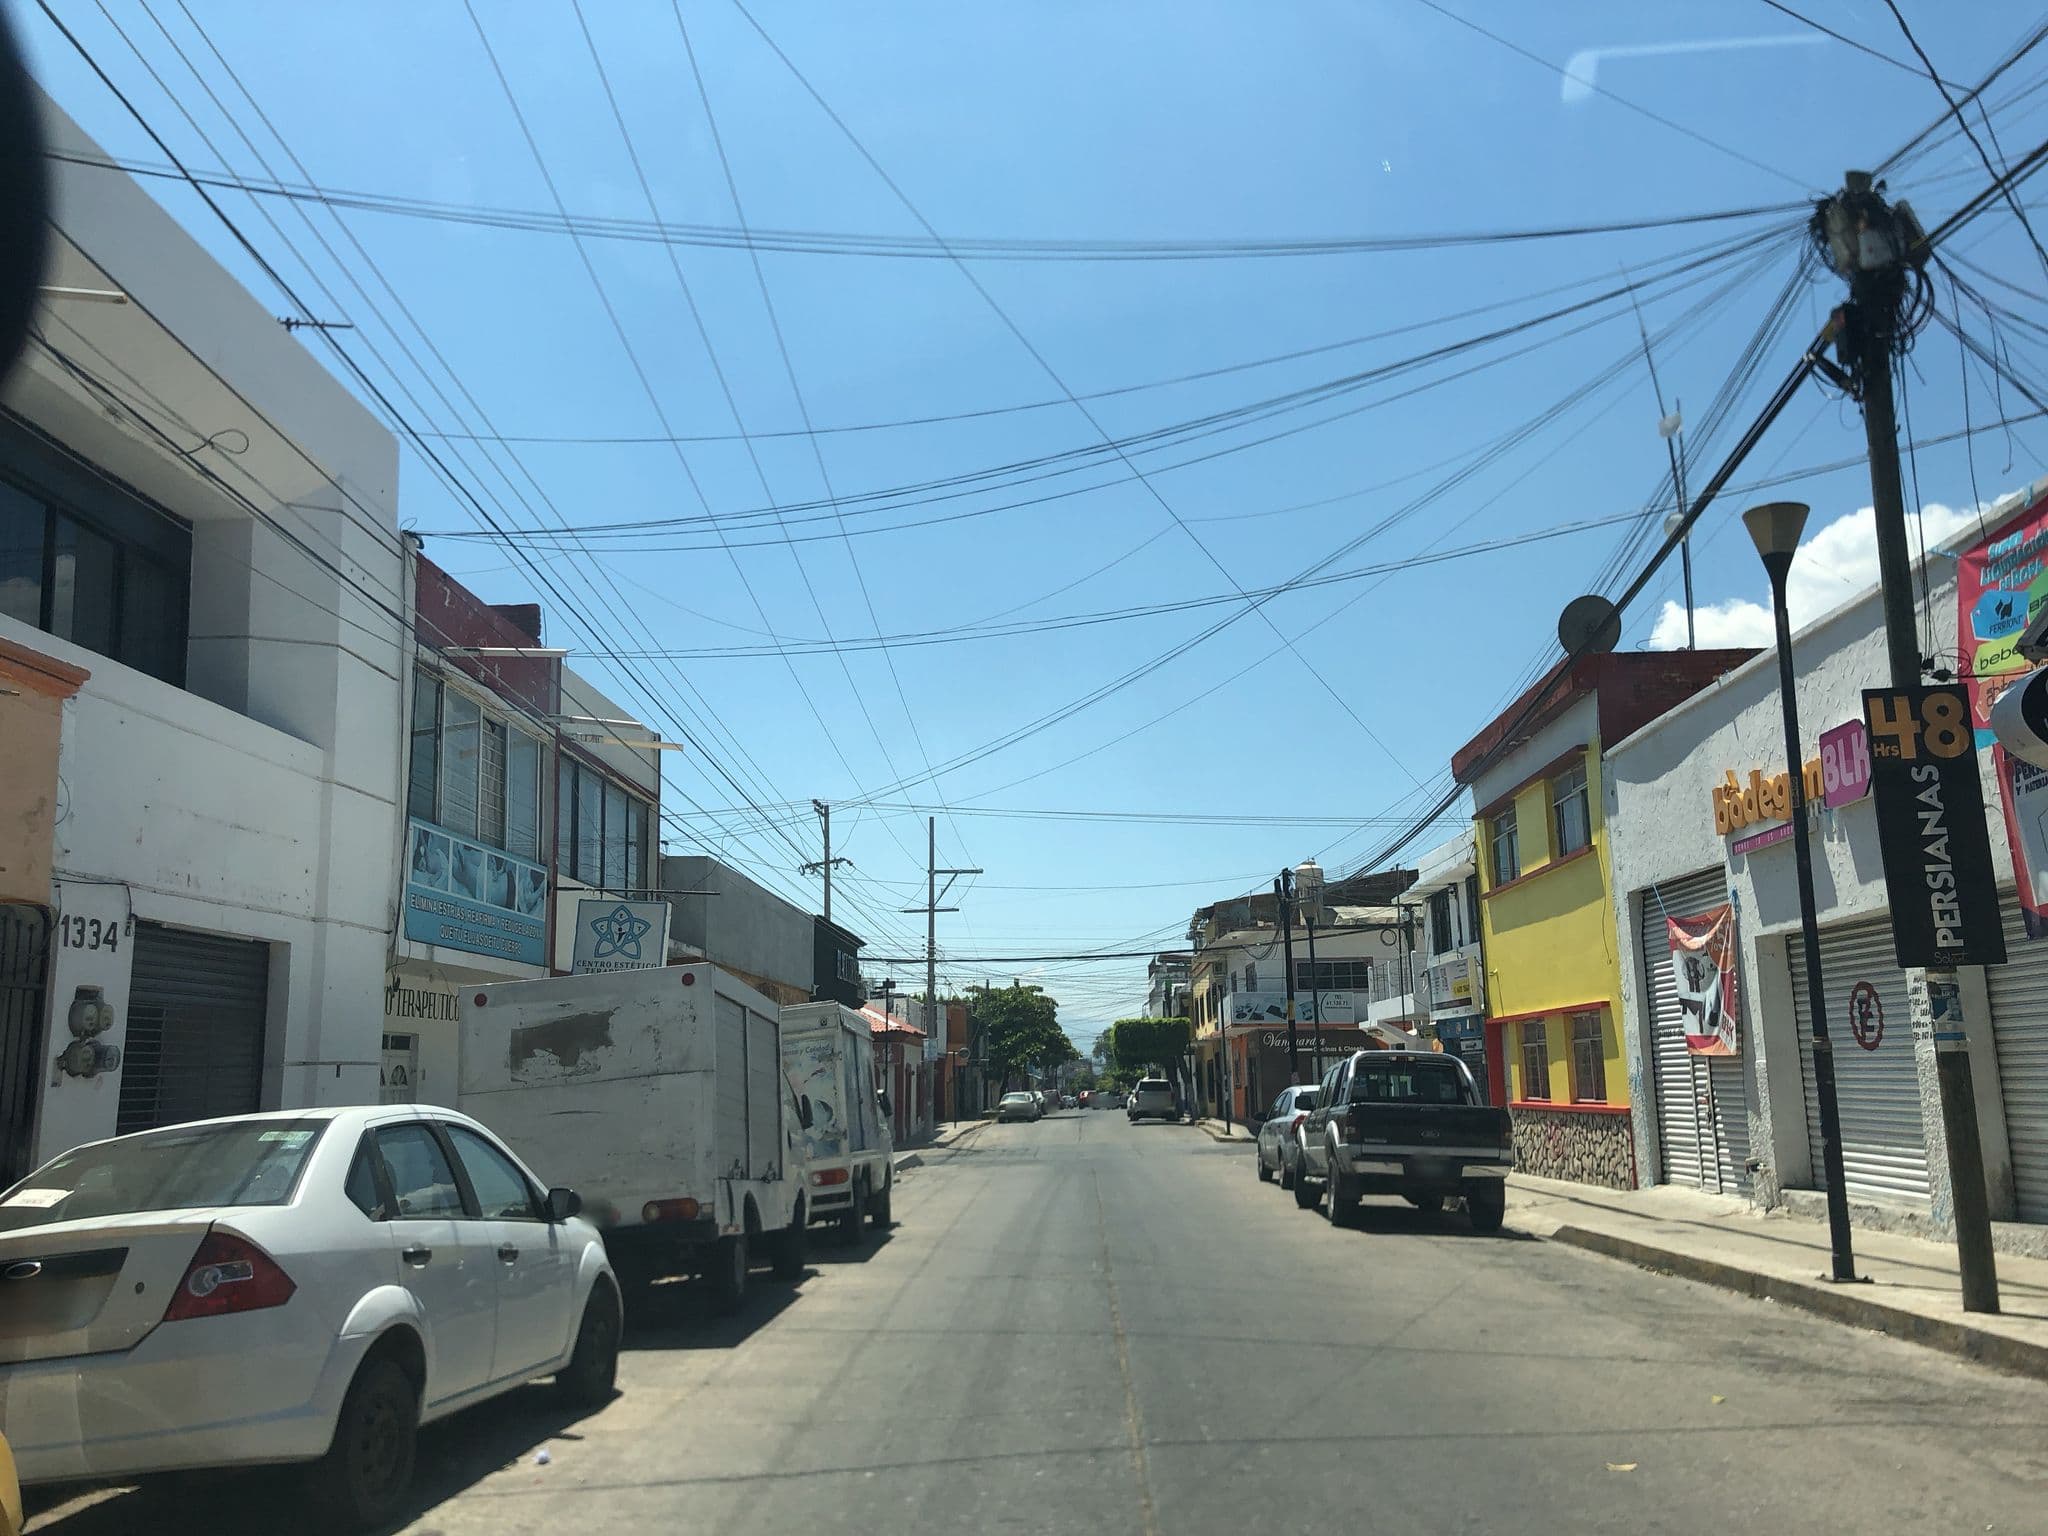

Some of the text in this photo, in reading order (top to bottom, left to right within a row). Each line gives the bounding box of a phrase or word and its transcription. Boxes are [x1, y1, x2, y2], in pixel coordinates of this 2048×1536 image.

[1868, 692, 1970, 759] 48
[1873, 742, 1900, 758] Hrs
[1822, 729, 1871, 793] BLK
[1712, 758, 1825, 836] bodegn
[1911, 764, 1964, 948] PERSIANAS
[61, 914, 118, 953] 1334
[576, 960, 611, 968] CENTRO
